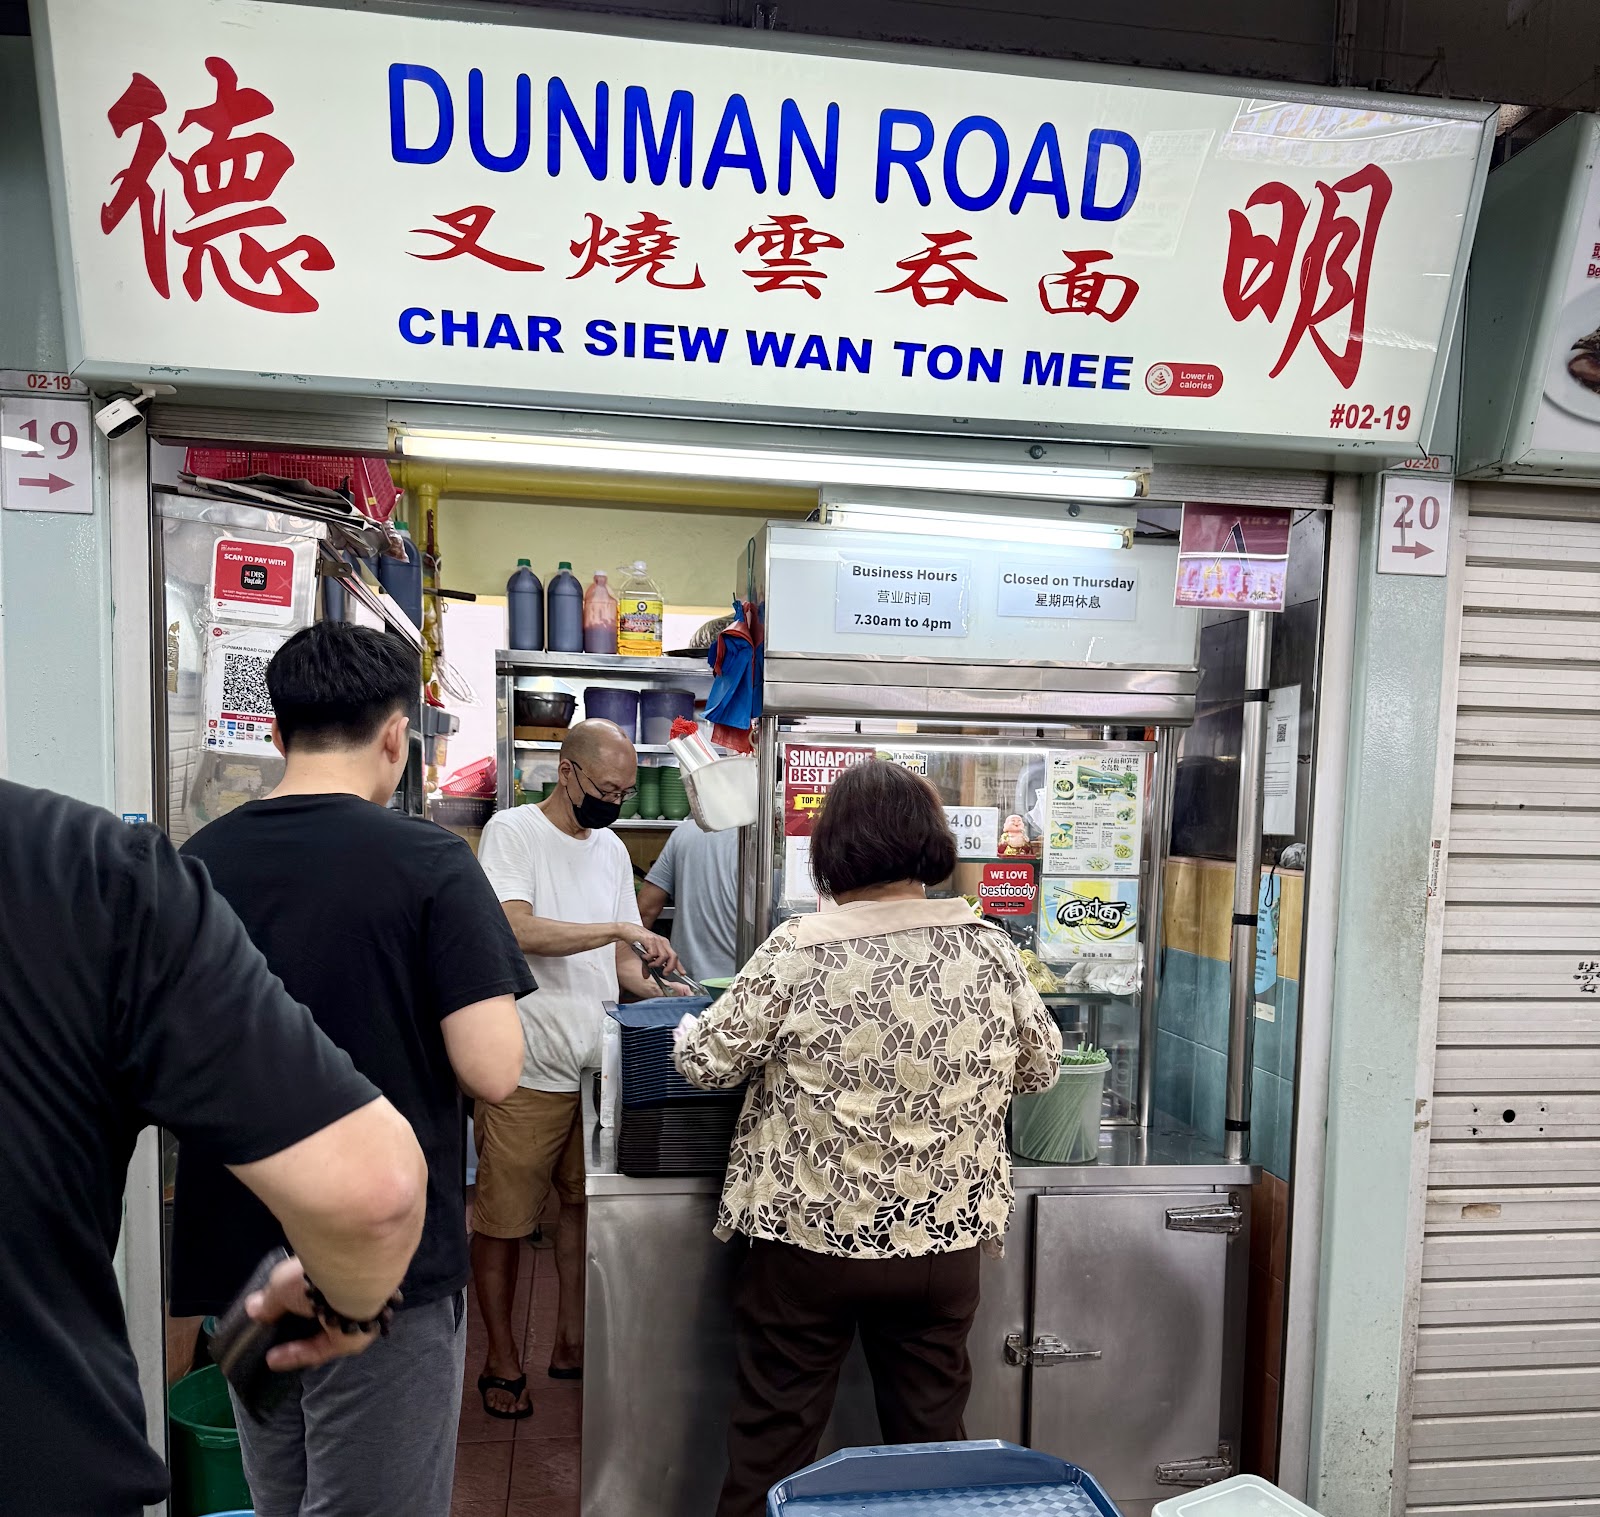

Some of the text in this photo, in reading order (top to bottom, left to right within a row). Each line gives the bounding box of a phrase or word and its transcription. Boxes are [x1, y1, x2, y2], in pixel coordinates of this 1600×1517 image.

[388, 63, 1141, 222] DUNMAN ROAD
[101, 56, 335, 314] 德
[405, 205, 1140, 323] 叉燒雲吞面
[1222, 163, 1393, 389] 明
[398, 307, 1131, 391] CHAR SIEW WAN TON MEE
[27, 374, 71, 390] 02-19
[1180, 371, 1205, 380] Lower
[1206, 372, 1215, 380] in
[1179, 381, 1213, 390] calories
[1330, 404, 1411, 430] #02-19
[19, 419, 78, 460] 19
[1404, 457, 1440, 470] 02-20
[1393, 494, 1440, 530] 20
[224, 553, 243, 561] SCAN
[254, 556, 268, 564] PAY
[268, 558, 287, 567] WITH
[250, 570, 265, 578] DBS
[852, 565, 958, 582] Business Hours
[1003, 573, 1135, 591] Closed on Thursday
[877, 589, 931, 606] 营业时间
[1034, 593, 1101, 609] 星期四休息
[854, 614, 952, 632] 7.30am to 4pm
[791, 768, 824, 782] BEST
[802, 796, 814, 804] TOP
[990, 870, 1028, 880] WE LOVE
[980, 883, 1035, 899] bestfoody
